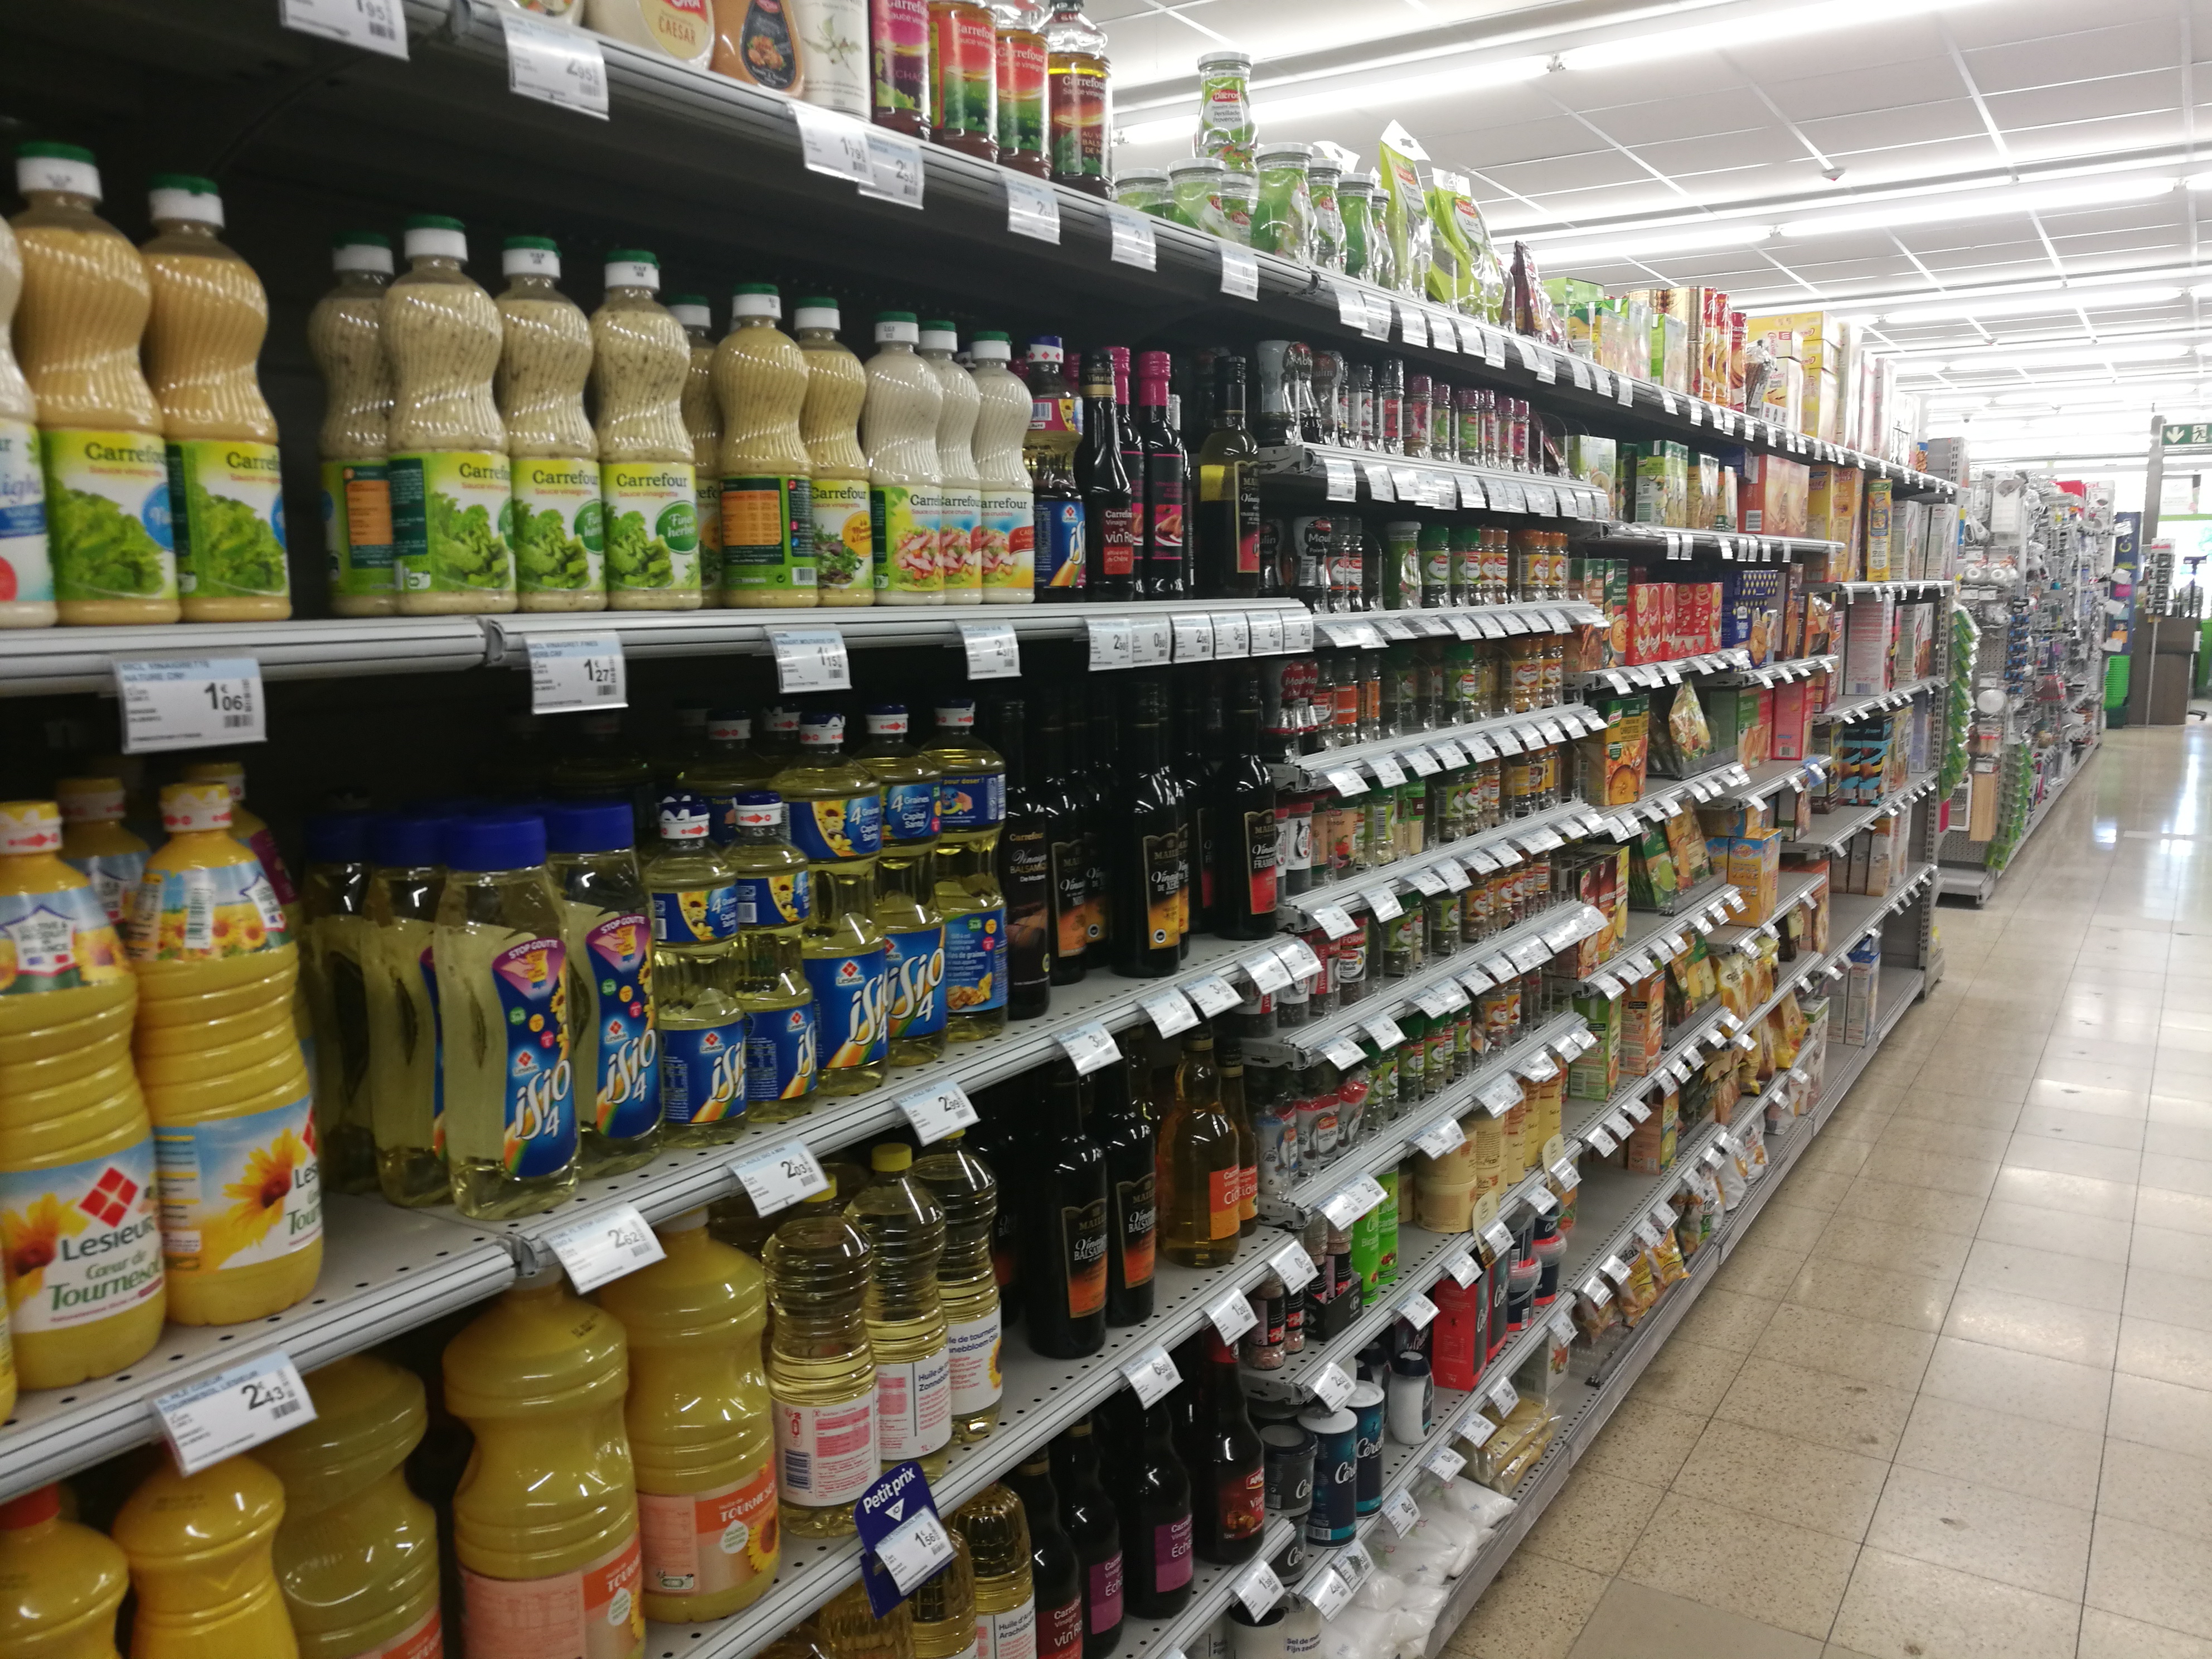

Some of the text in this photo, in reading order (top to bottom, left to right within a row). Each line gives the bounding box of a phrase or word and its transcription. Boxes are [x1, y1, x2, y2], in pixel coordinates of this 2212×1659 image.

[658, 14, 696, 46] CAESAR
[617, 473, 688, 488] Carrefour
[811, 487, 867, 500] Carrefour
[891, 794, 930, 812] 4 Graines
[849, 806, 862, 825] 4
[902, 811, 926, 822] Capital
[905, 819, 924, 829] Santé
[601, 914, 646, 934] STOP GOUTTE
[508, 939, 558, 960] STOP GOUTTE
[915, 990, 934, 1022] 4
[632, 1071, 647, 1103] 4
[544, 1105, 560, 1138] 4
[61, 1214, 156, 1262] Lesieur
[957, 1335, 968, 1343] de
[919, 1370, 937, 1381] Huile
[862, 1467, 916, 1515] Petit prix
[998, 1621, 1017, 1631] Huile
[1287, 1644, 1300, 1653] Fijn
